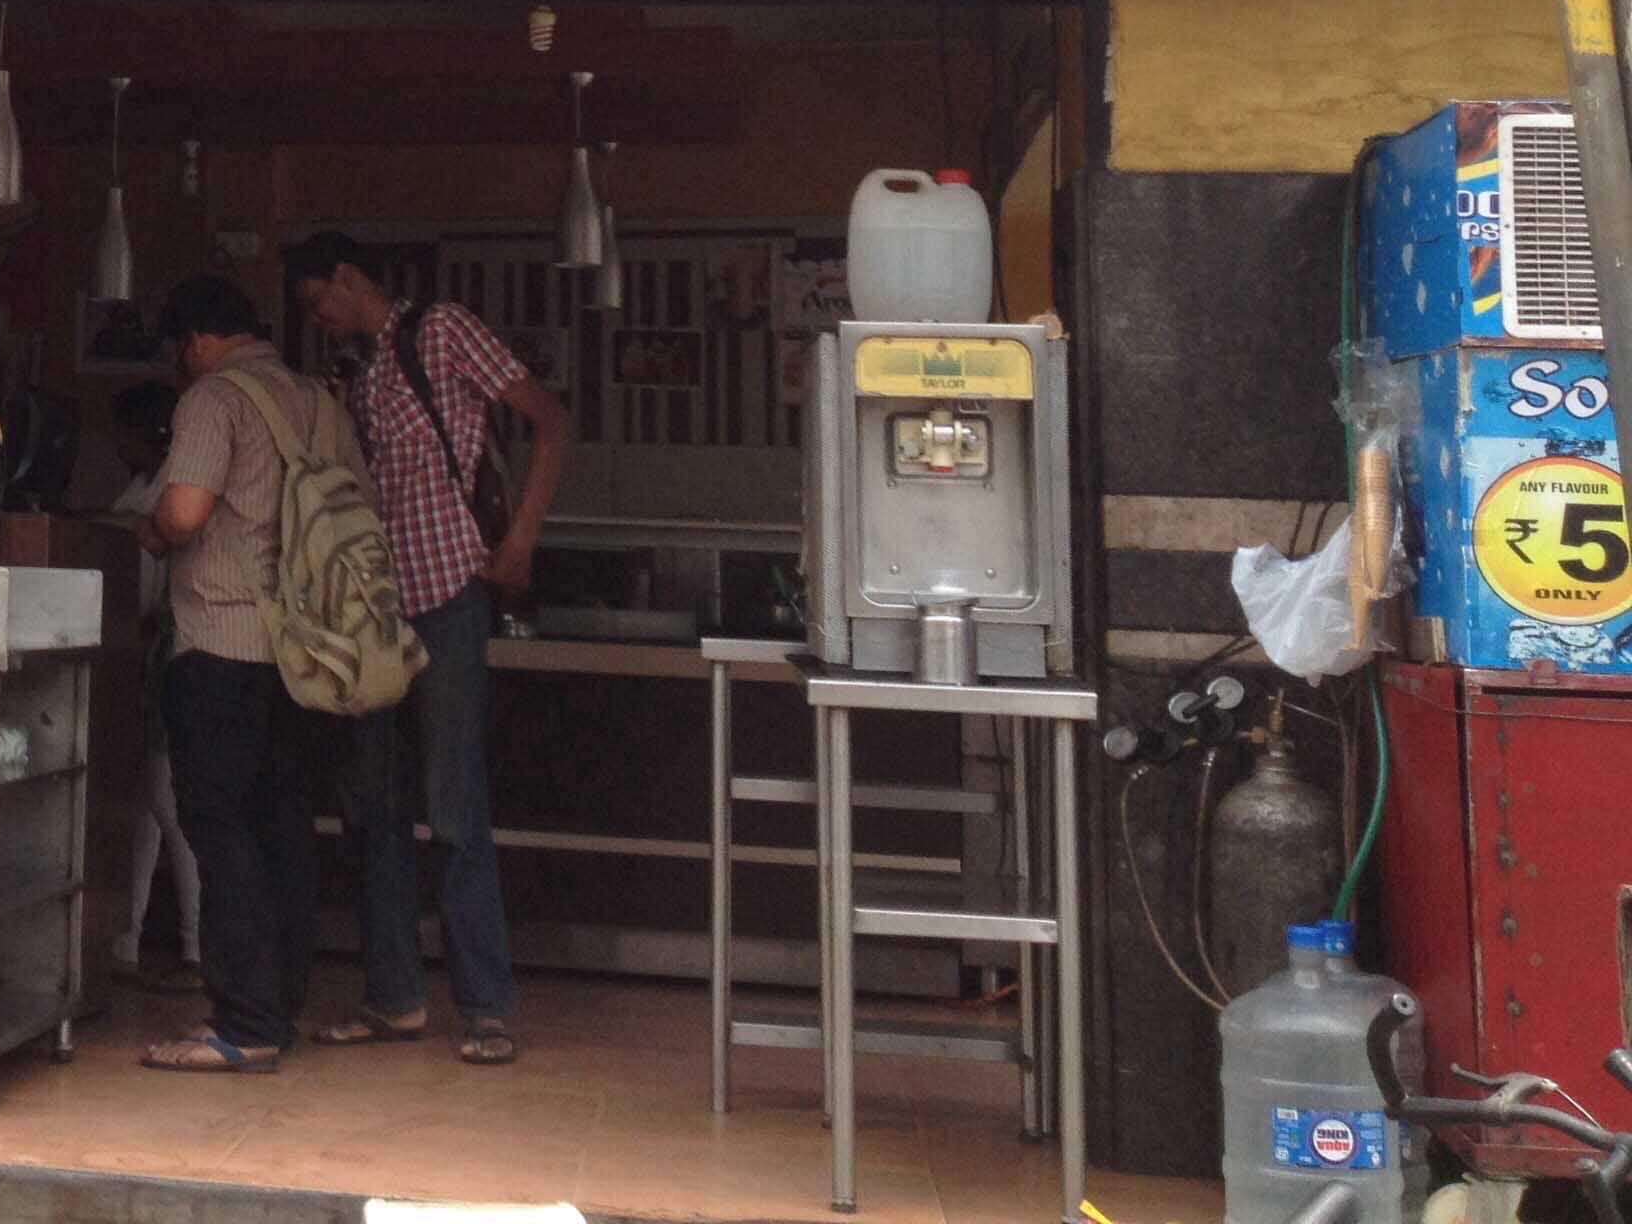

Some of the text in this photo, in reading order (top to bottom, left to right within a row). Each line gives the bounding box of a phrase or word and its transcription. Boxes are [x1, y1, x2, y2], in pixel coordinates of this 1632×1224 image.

[1519, 480, 1609, 495] ANY FLAVOUR
[1558, 502, 1630, 584] 5
[1534, 587, 1603, 602] ONLY
